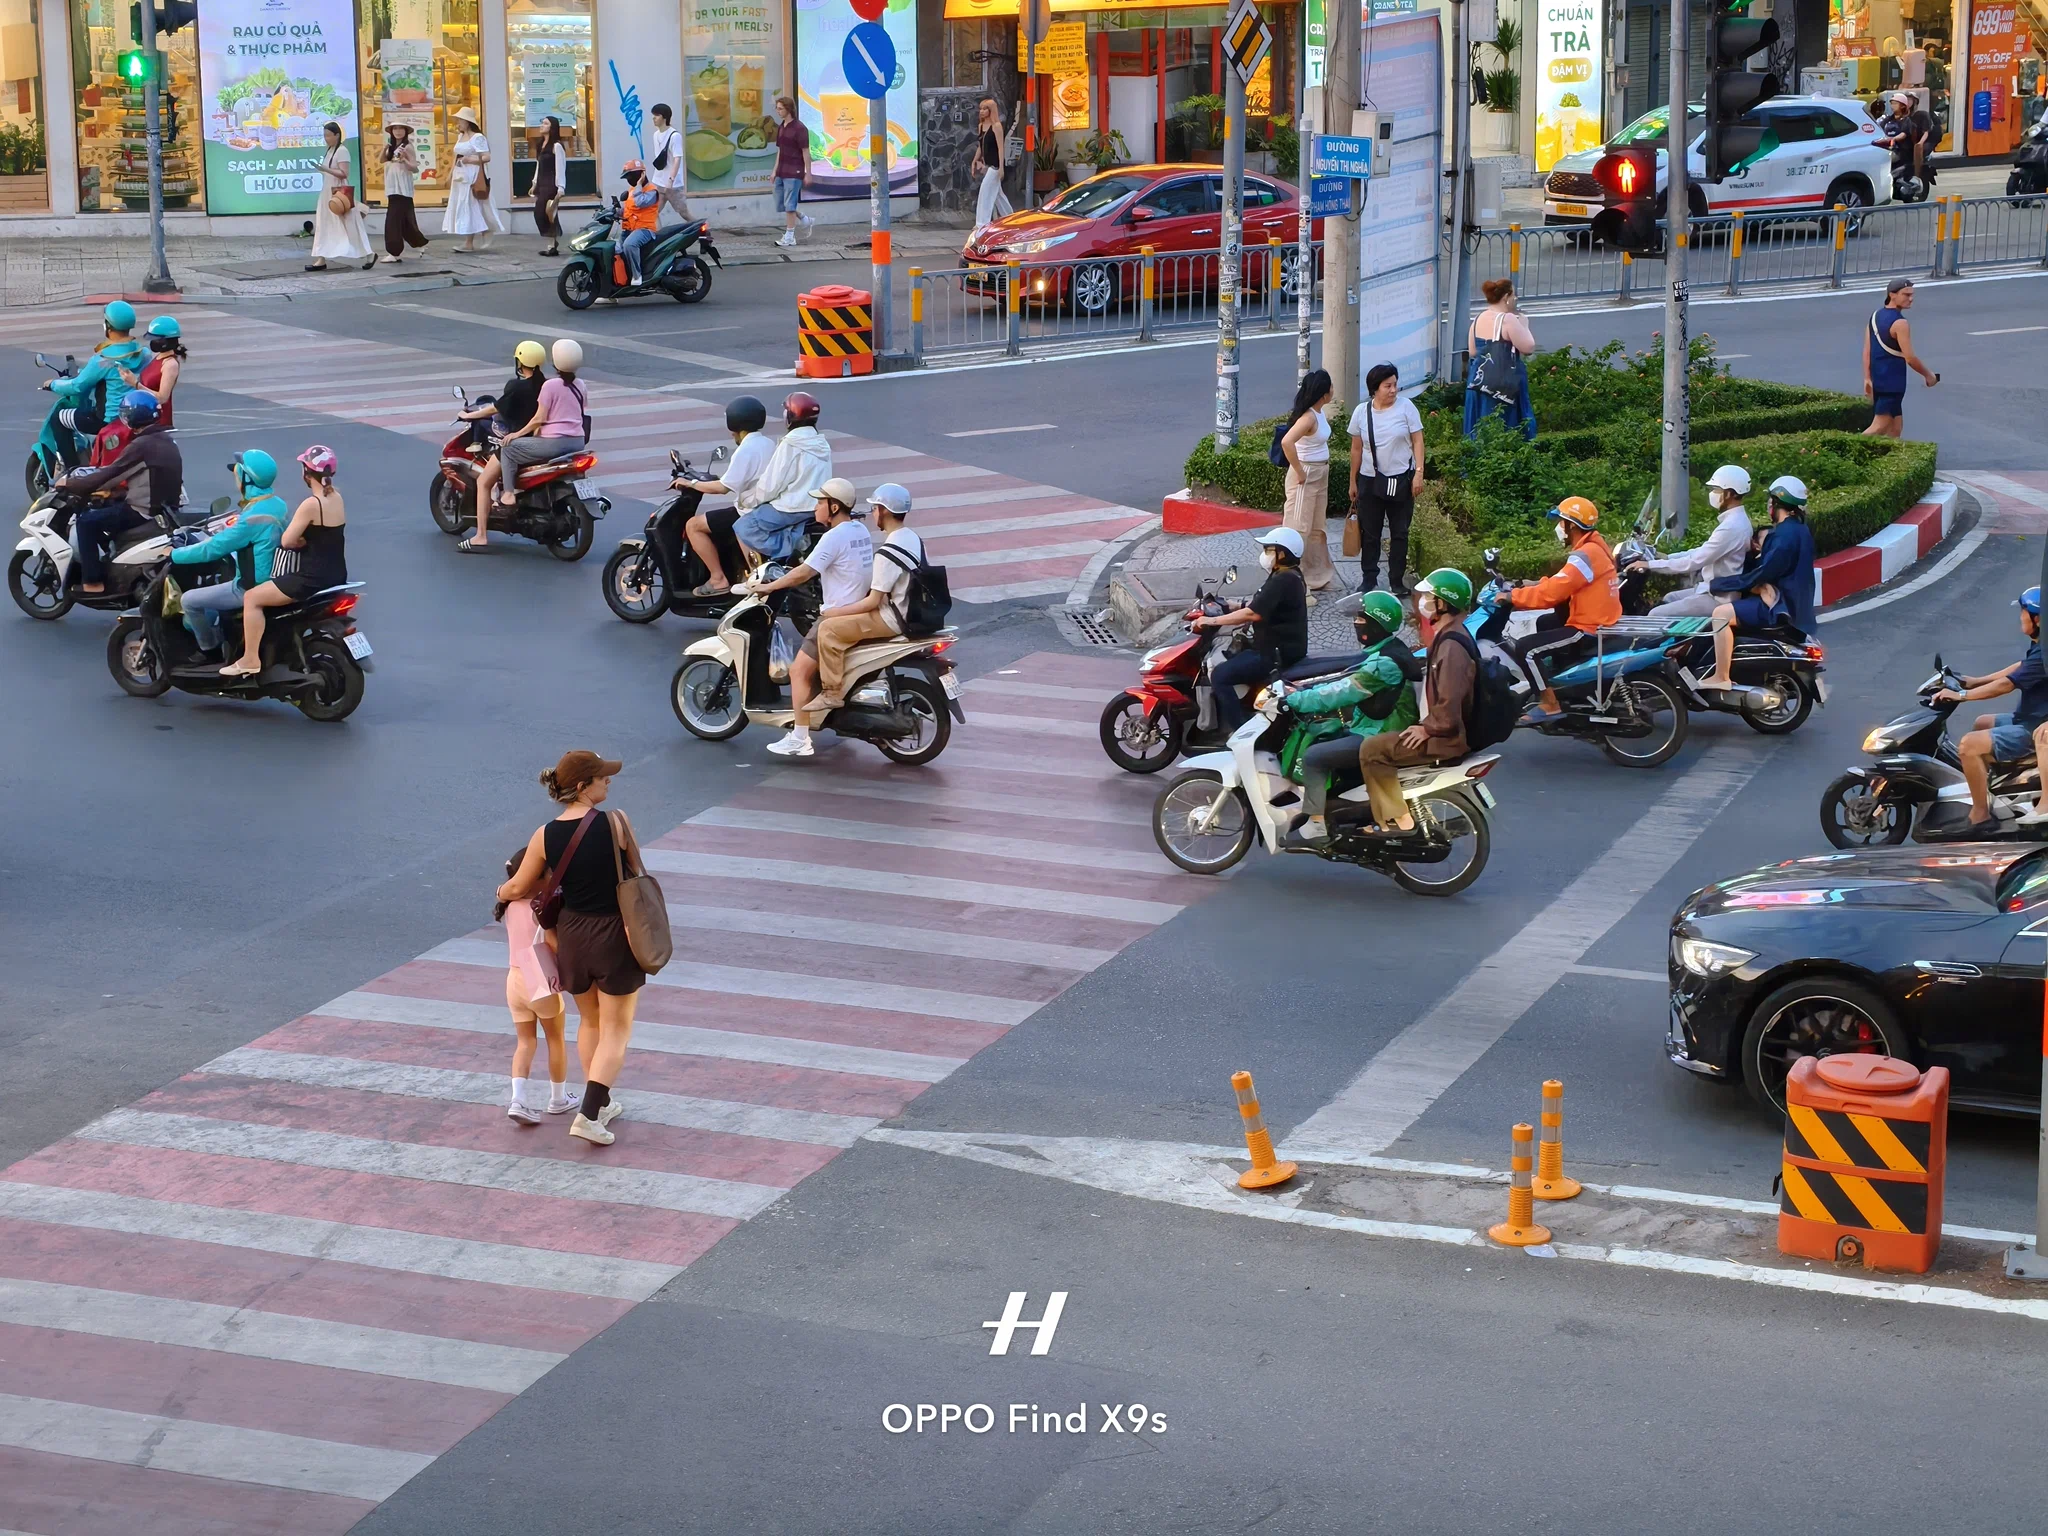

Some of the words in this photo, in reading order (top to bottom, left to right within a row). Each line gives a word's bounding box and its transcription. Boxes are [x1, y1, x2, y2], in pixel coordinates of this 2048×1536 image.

[712, 7, 738, 17] YOUR
[742, 7, 768, 17] FAST
[1373, 2, 1395, 10] CRANE
[1400, 1, 1414, 9] TEA
[1548, 0, 1593, 21] CHUẨN
[233, 26, 263, 37] RAU
[267, 22, 287, 37] CỦ
[290, 21, 322, 37] QUẢ
[735, 22, 773, 32] MEALS!
[1973, 9, 2000, 36] 699
[1999, 22, 2013, 33] VND
[1550, 24, 1591, 52] TRÀ
[227, 44, 236, 55] &
[239, 42, 280, 58] THỰC
[283, 38, 327, 54] PHẨM
[1973, 54, 1991, 65] 75%
[1993, 52, 2012, 63] OFF
[1552, 63, 1573, 79] ĐẬM
[1575, 64, 1588, 78] VỊ
[1326, 141, 1359, 153] ĐƯỜNG
[228, 160, 266, 174] SẠCH
[276, 159, 298, 170] AN
[1809, 165, 1818, 175] 27
[1820, 164, 1829, 174] 27
[254, 176, 288, 190] HỮU
[292, 176, 314, 189] CƠ
[1319, 181, 1343, 192] ĐƯỜNG
[1441, 587, 1459, 600] Grab
[1373, 607, 1391, 622] Grab
